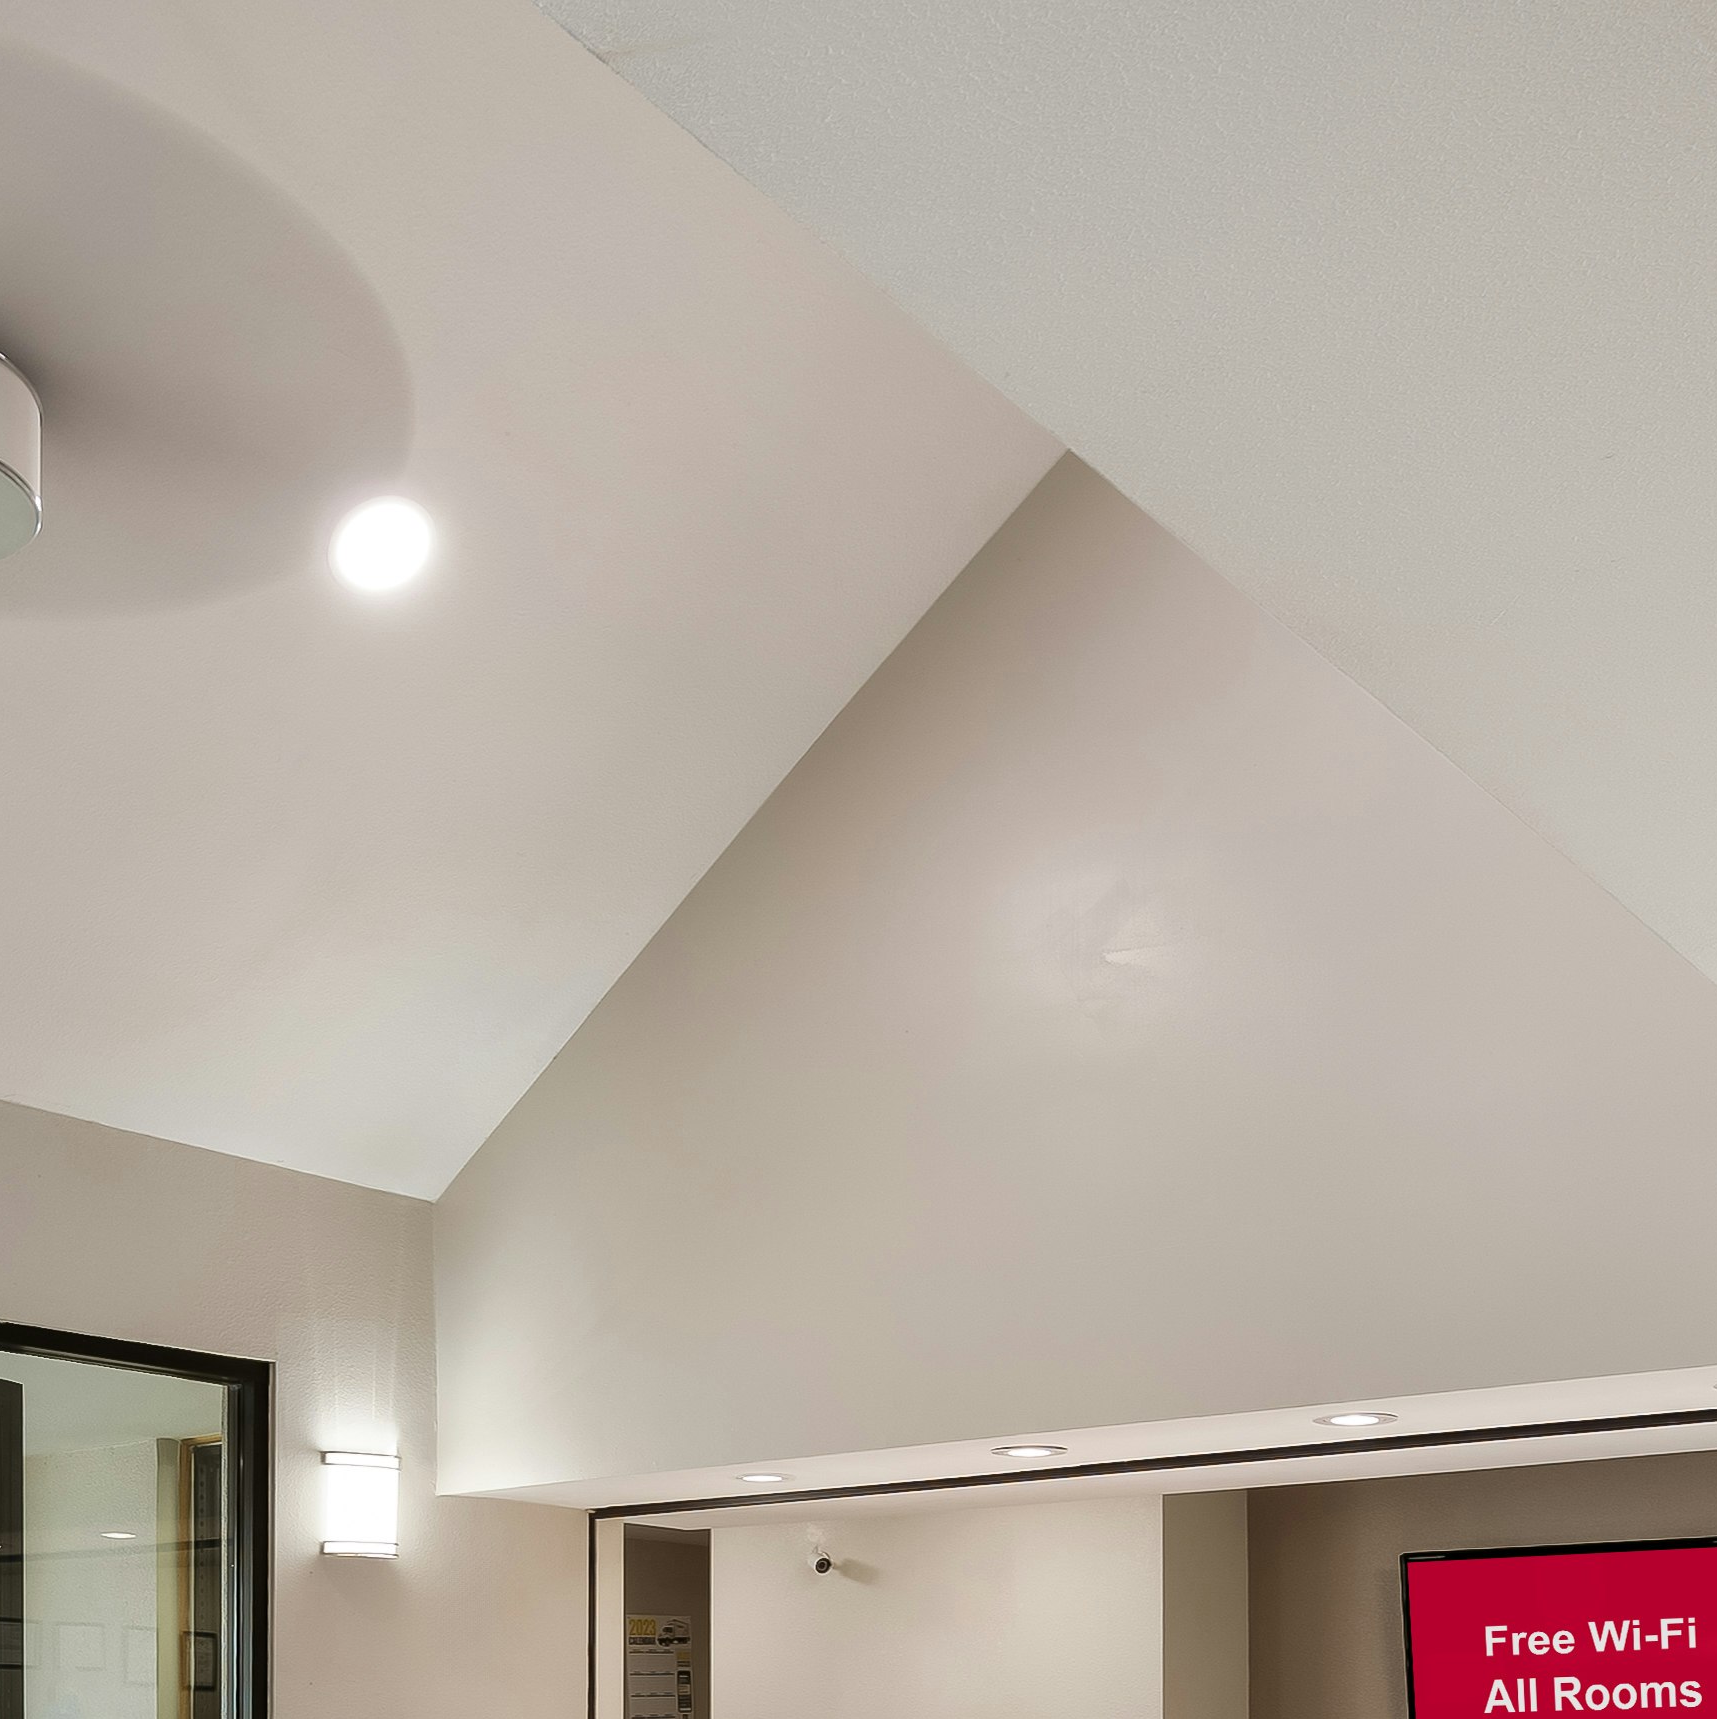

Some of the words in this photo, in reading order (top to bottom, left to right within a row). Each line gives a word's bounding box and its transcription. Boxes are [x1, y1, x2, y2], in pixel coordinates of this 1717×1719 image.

[629, 1619, 656, 1636] 2023
[1484, 1625, 1576, 1657] Free
[1587, 1617, 1697, 1652] Wi-Fi
[1484, 1678, 1538, 1714] All
[1553, 1677, 1703, 1712] Rooms
